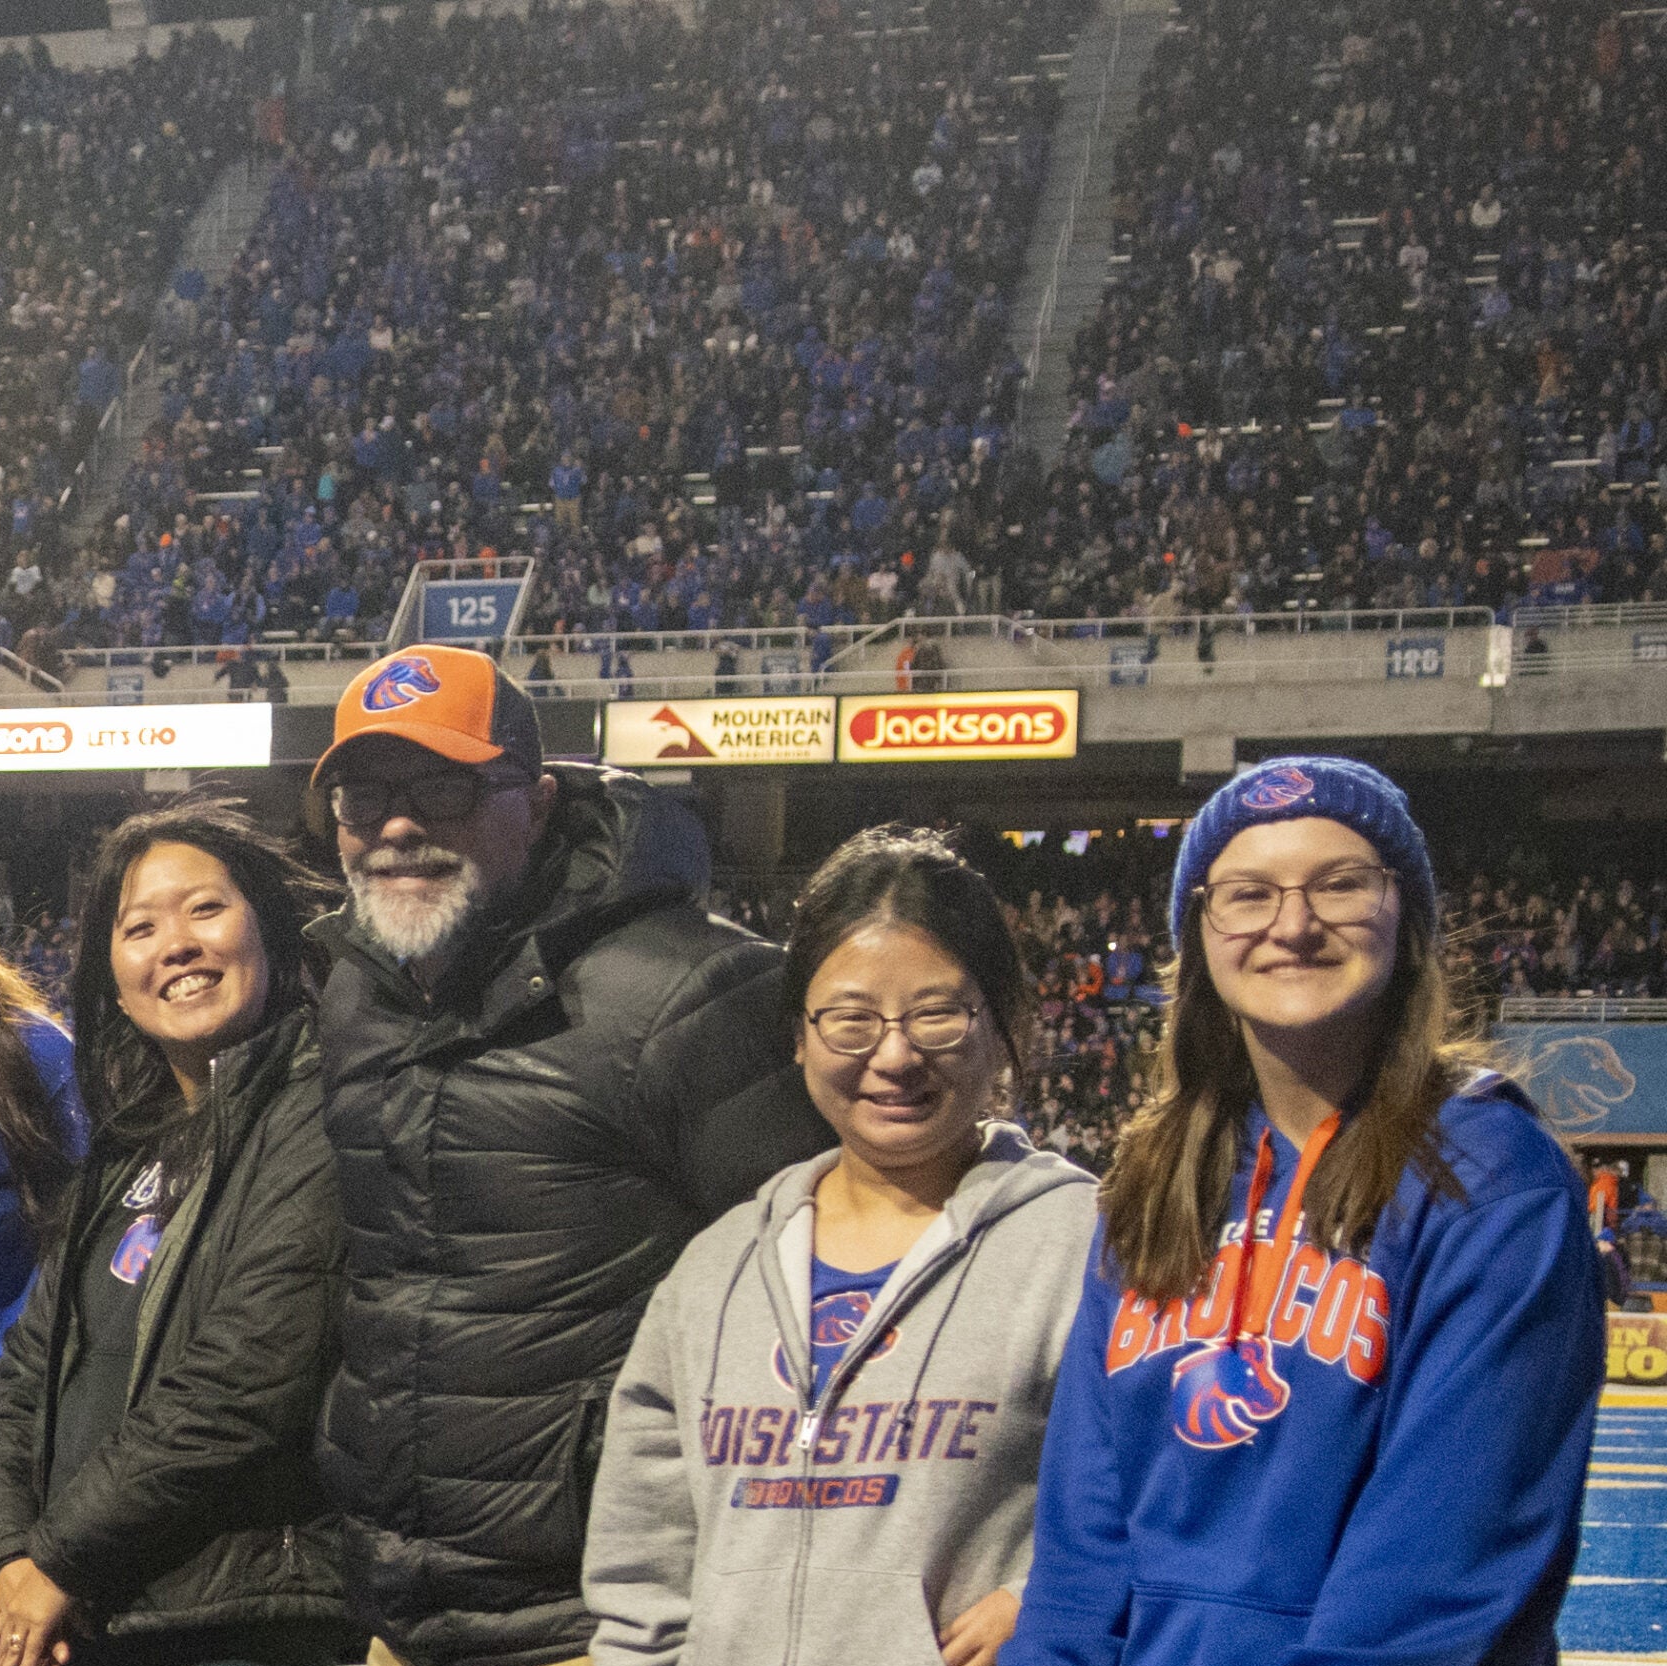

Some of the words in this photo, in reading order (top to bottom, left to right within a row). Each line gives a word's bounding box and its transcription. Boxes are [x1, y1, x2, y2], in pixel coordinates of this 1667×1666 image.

[447, 597, 496, 626] 125
[712, 708, 832, 728] MOUNTAIN
[864, 709, 1055, 749] Jacksons
[719, 729, 822, 748] AMERICA
[812, 1399, 998, 1467] STATE
